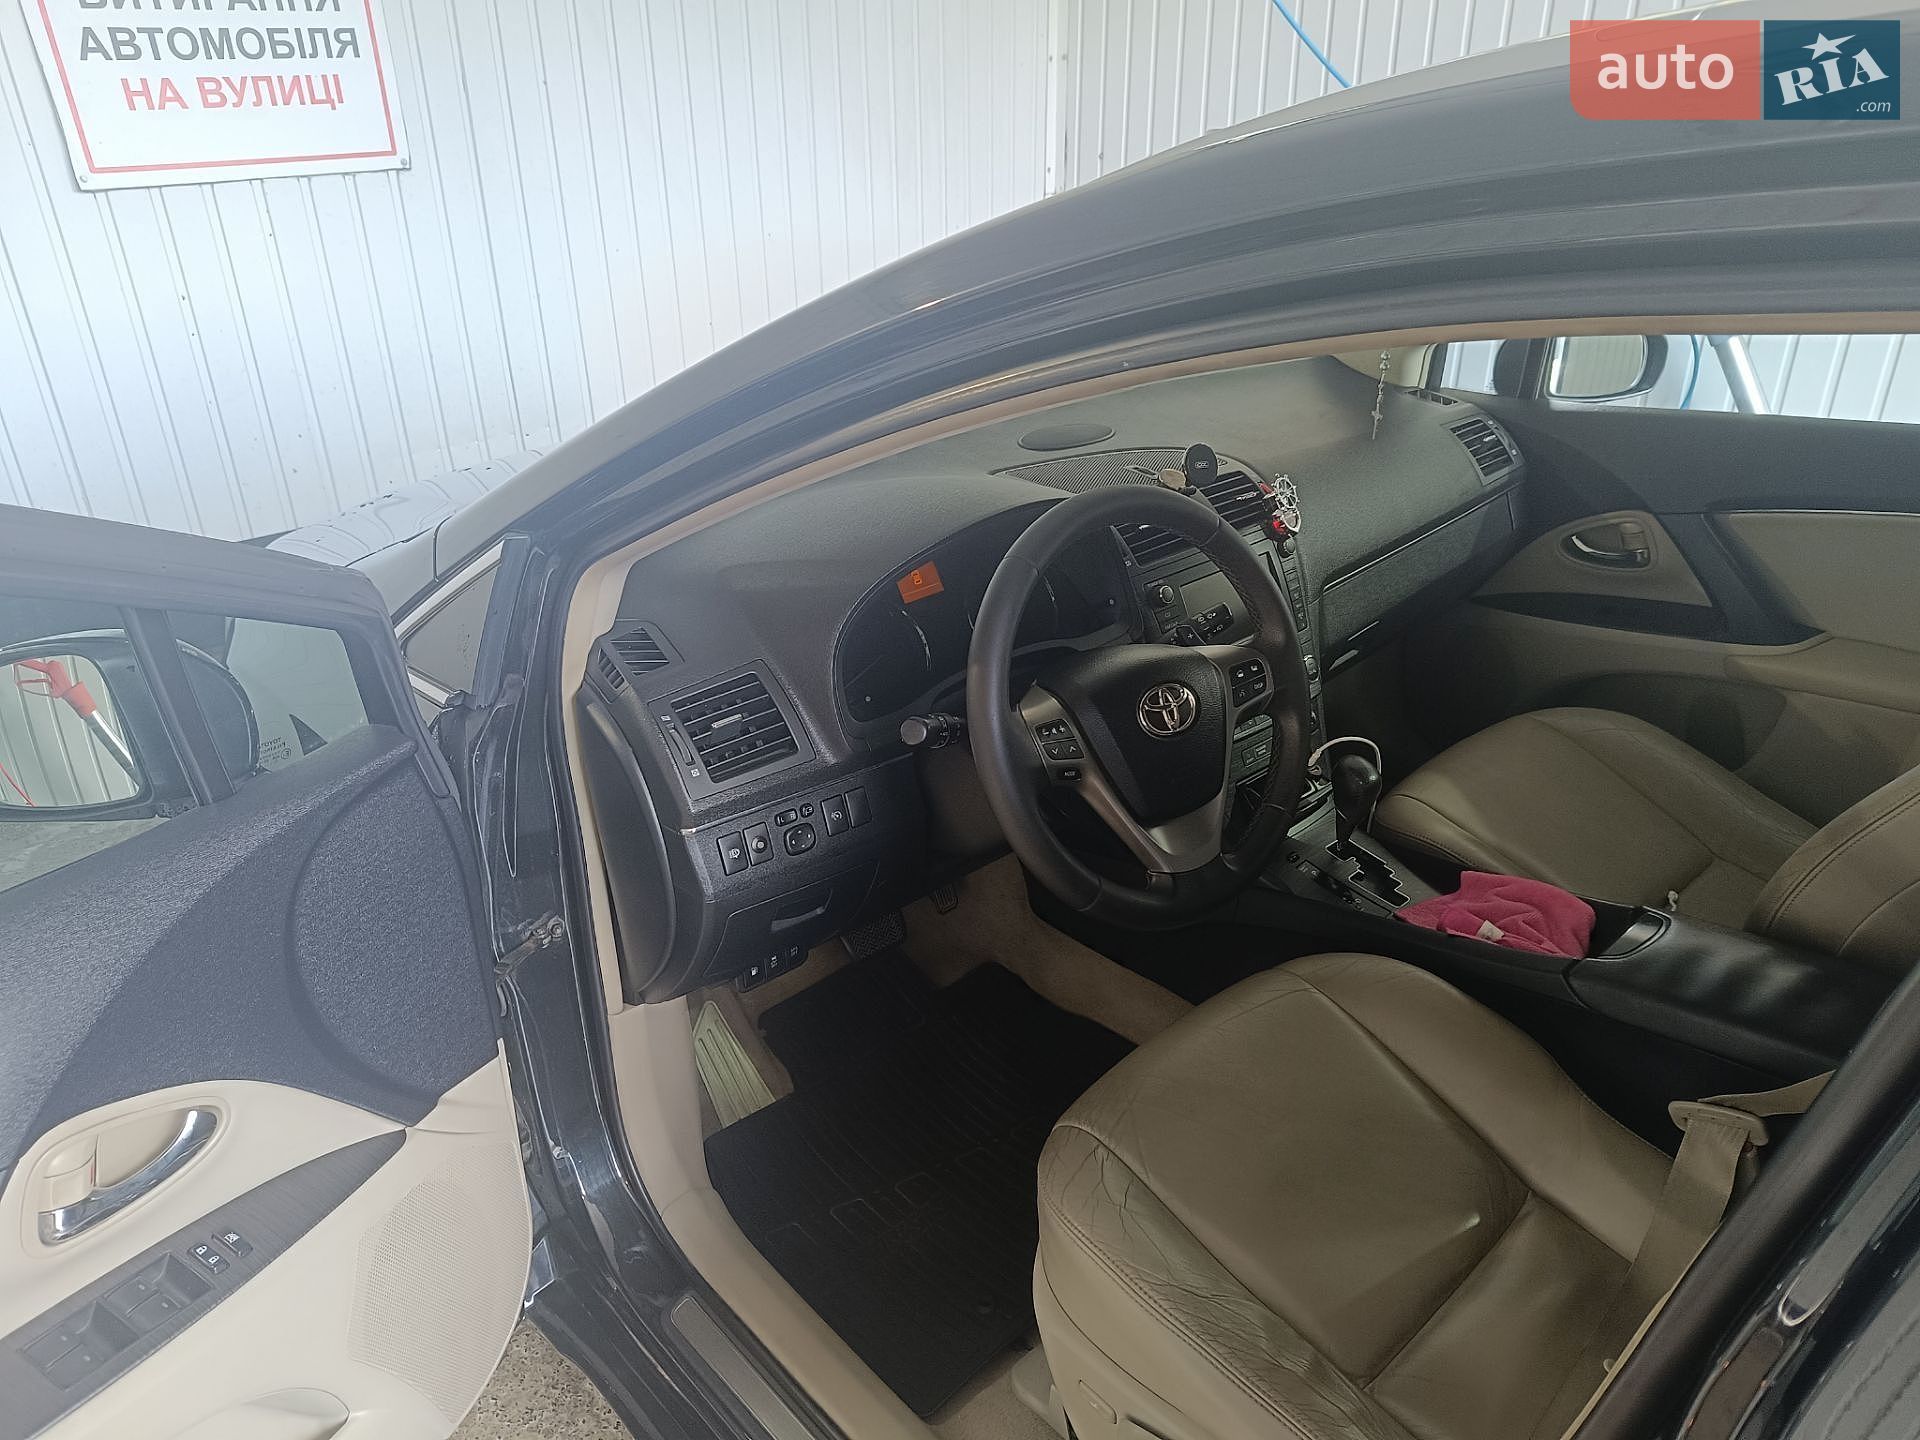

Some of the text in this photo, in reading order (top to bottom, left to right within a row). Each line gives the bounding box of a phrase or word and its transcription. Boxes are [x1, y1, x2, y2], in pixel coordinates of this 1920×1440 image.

[81, 26, 360, 61] АВТОМОБІЛЯ
[120, 74, 344, 111] НА ВУЛИЦІ
